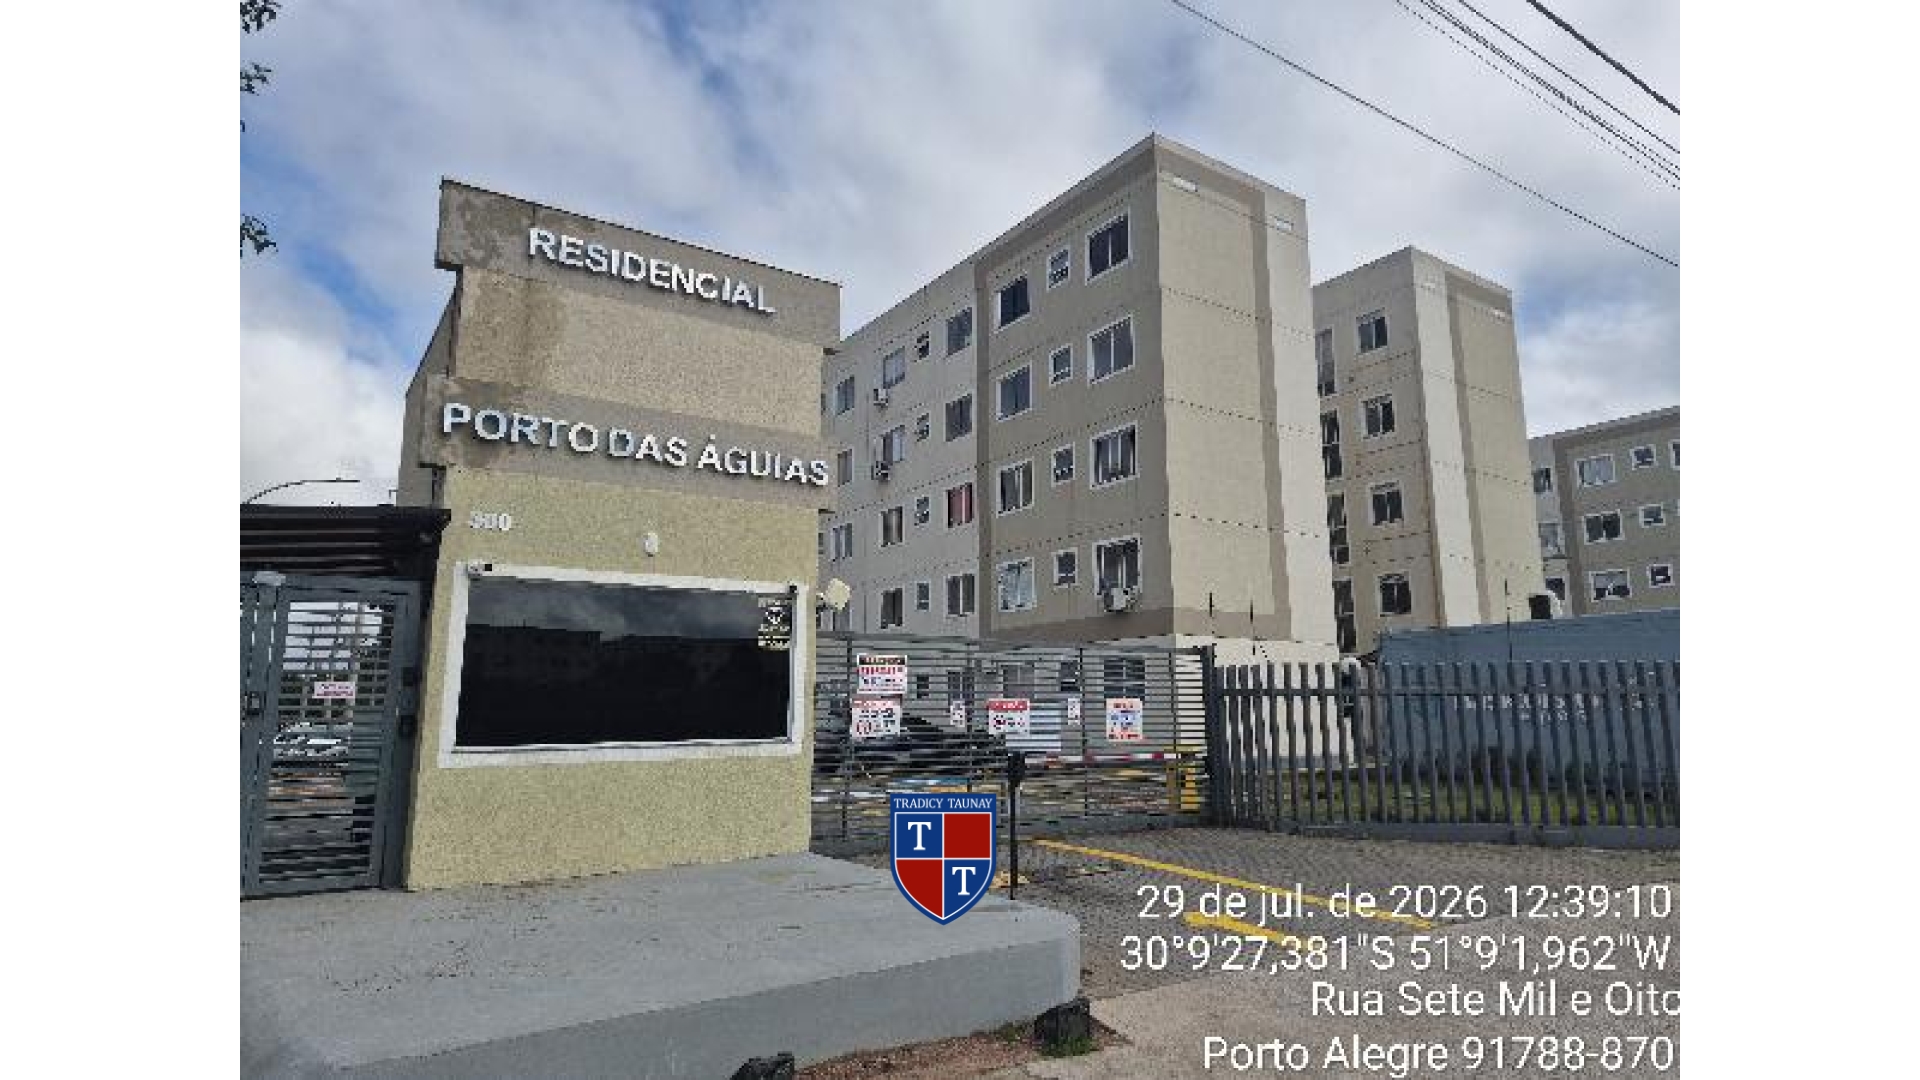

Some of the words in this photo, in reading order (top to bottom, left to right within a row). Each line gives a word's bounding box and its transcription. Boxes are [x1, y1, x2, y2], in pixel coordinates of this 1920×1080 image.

[528, 227, 777, 314] RESIDENCIAL
[442, 402, 600, 453] PORTO
[607, 428, 688, 467] DAS
[697, 433, 830, 486] ÁGUIAS
